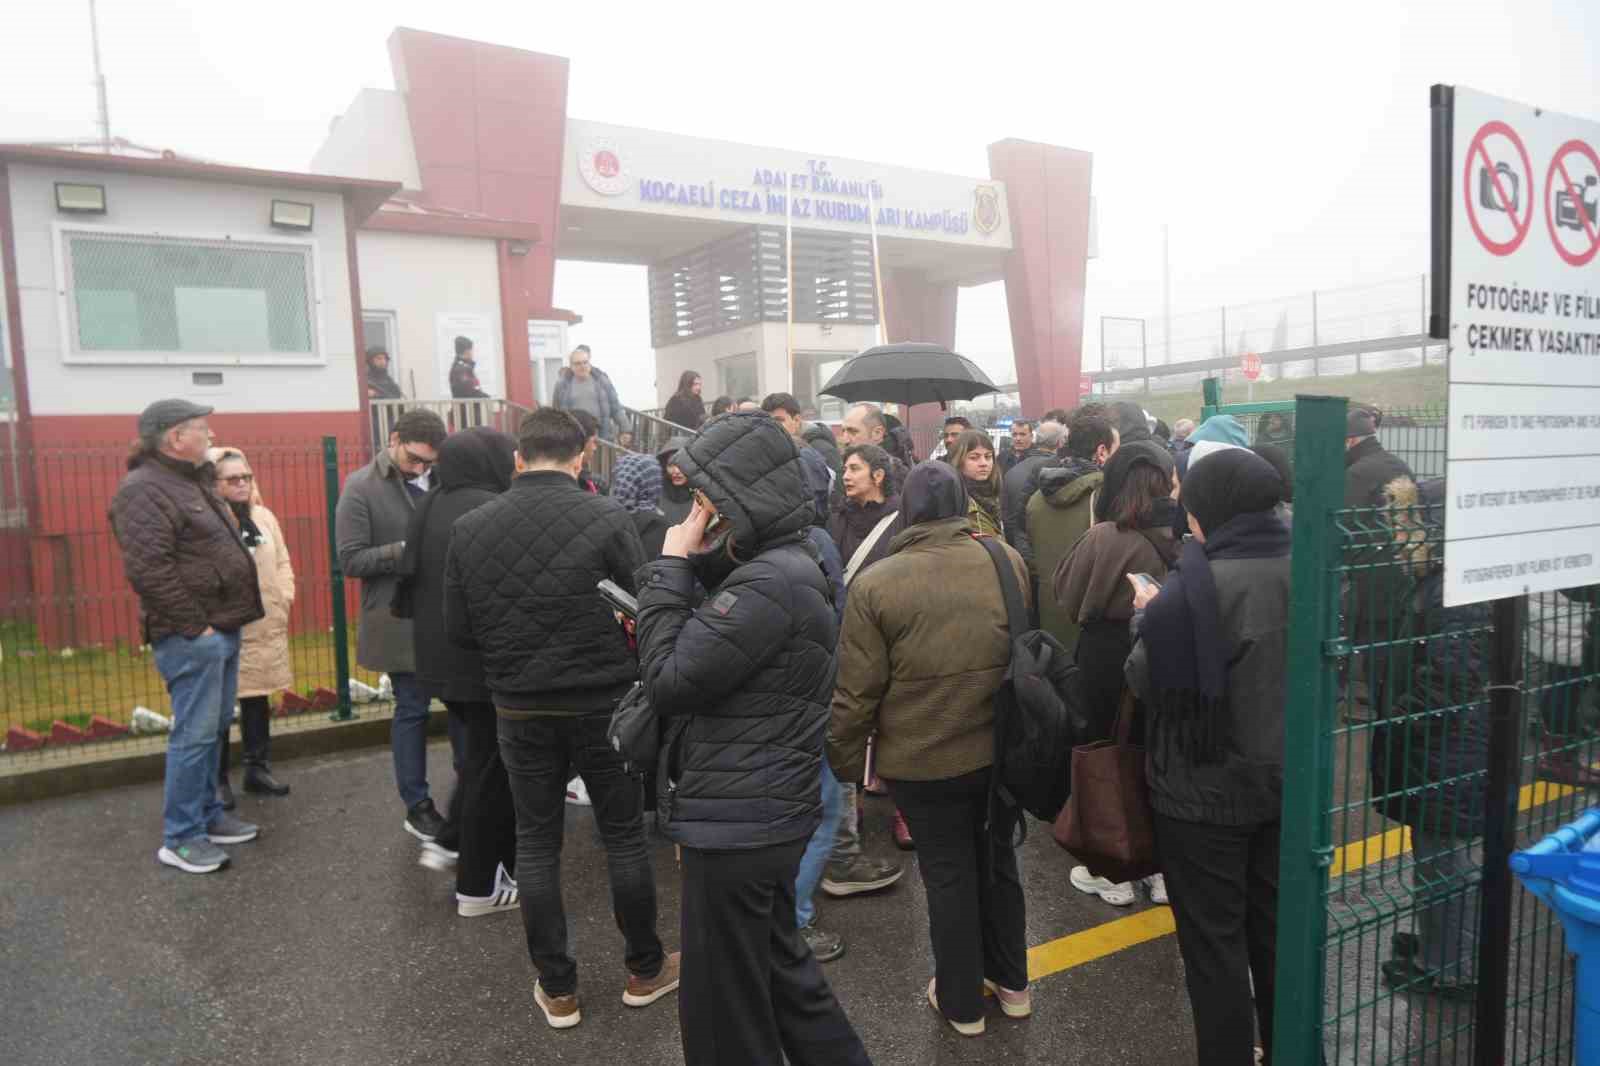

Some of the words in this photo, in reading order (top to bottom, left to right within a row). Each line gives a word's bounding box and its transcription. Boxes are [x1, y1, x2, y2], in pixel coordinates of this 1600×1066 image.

[808, 159, 831, 176] T.C.
[640, 178, 715, 208] KOCAELİ
[720, 188, 761, 210] CEZA
[815, 199, 901, 225] KURUMARI
[1467, 281, 1549, 315] FOTOĞRAF
[1554, 292, 1571, 317] VE
[1467, 323, 1534, 357] ÇEKMEK
